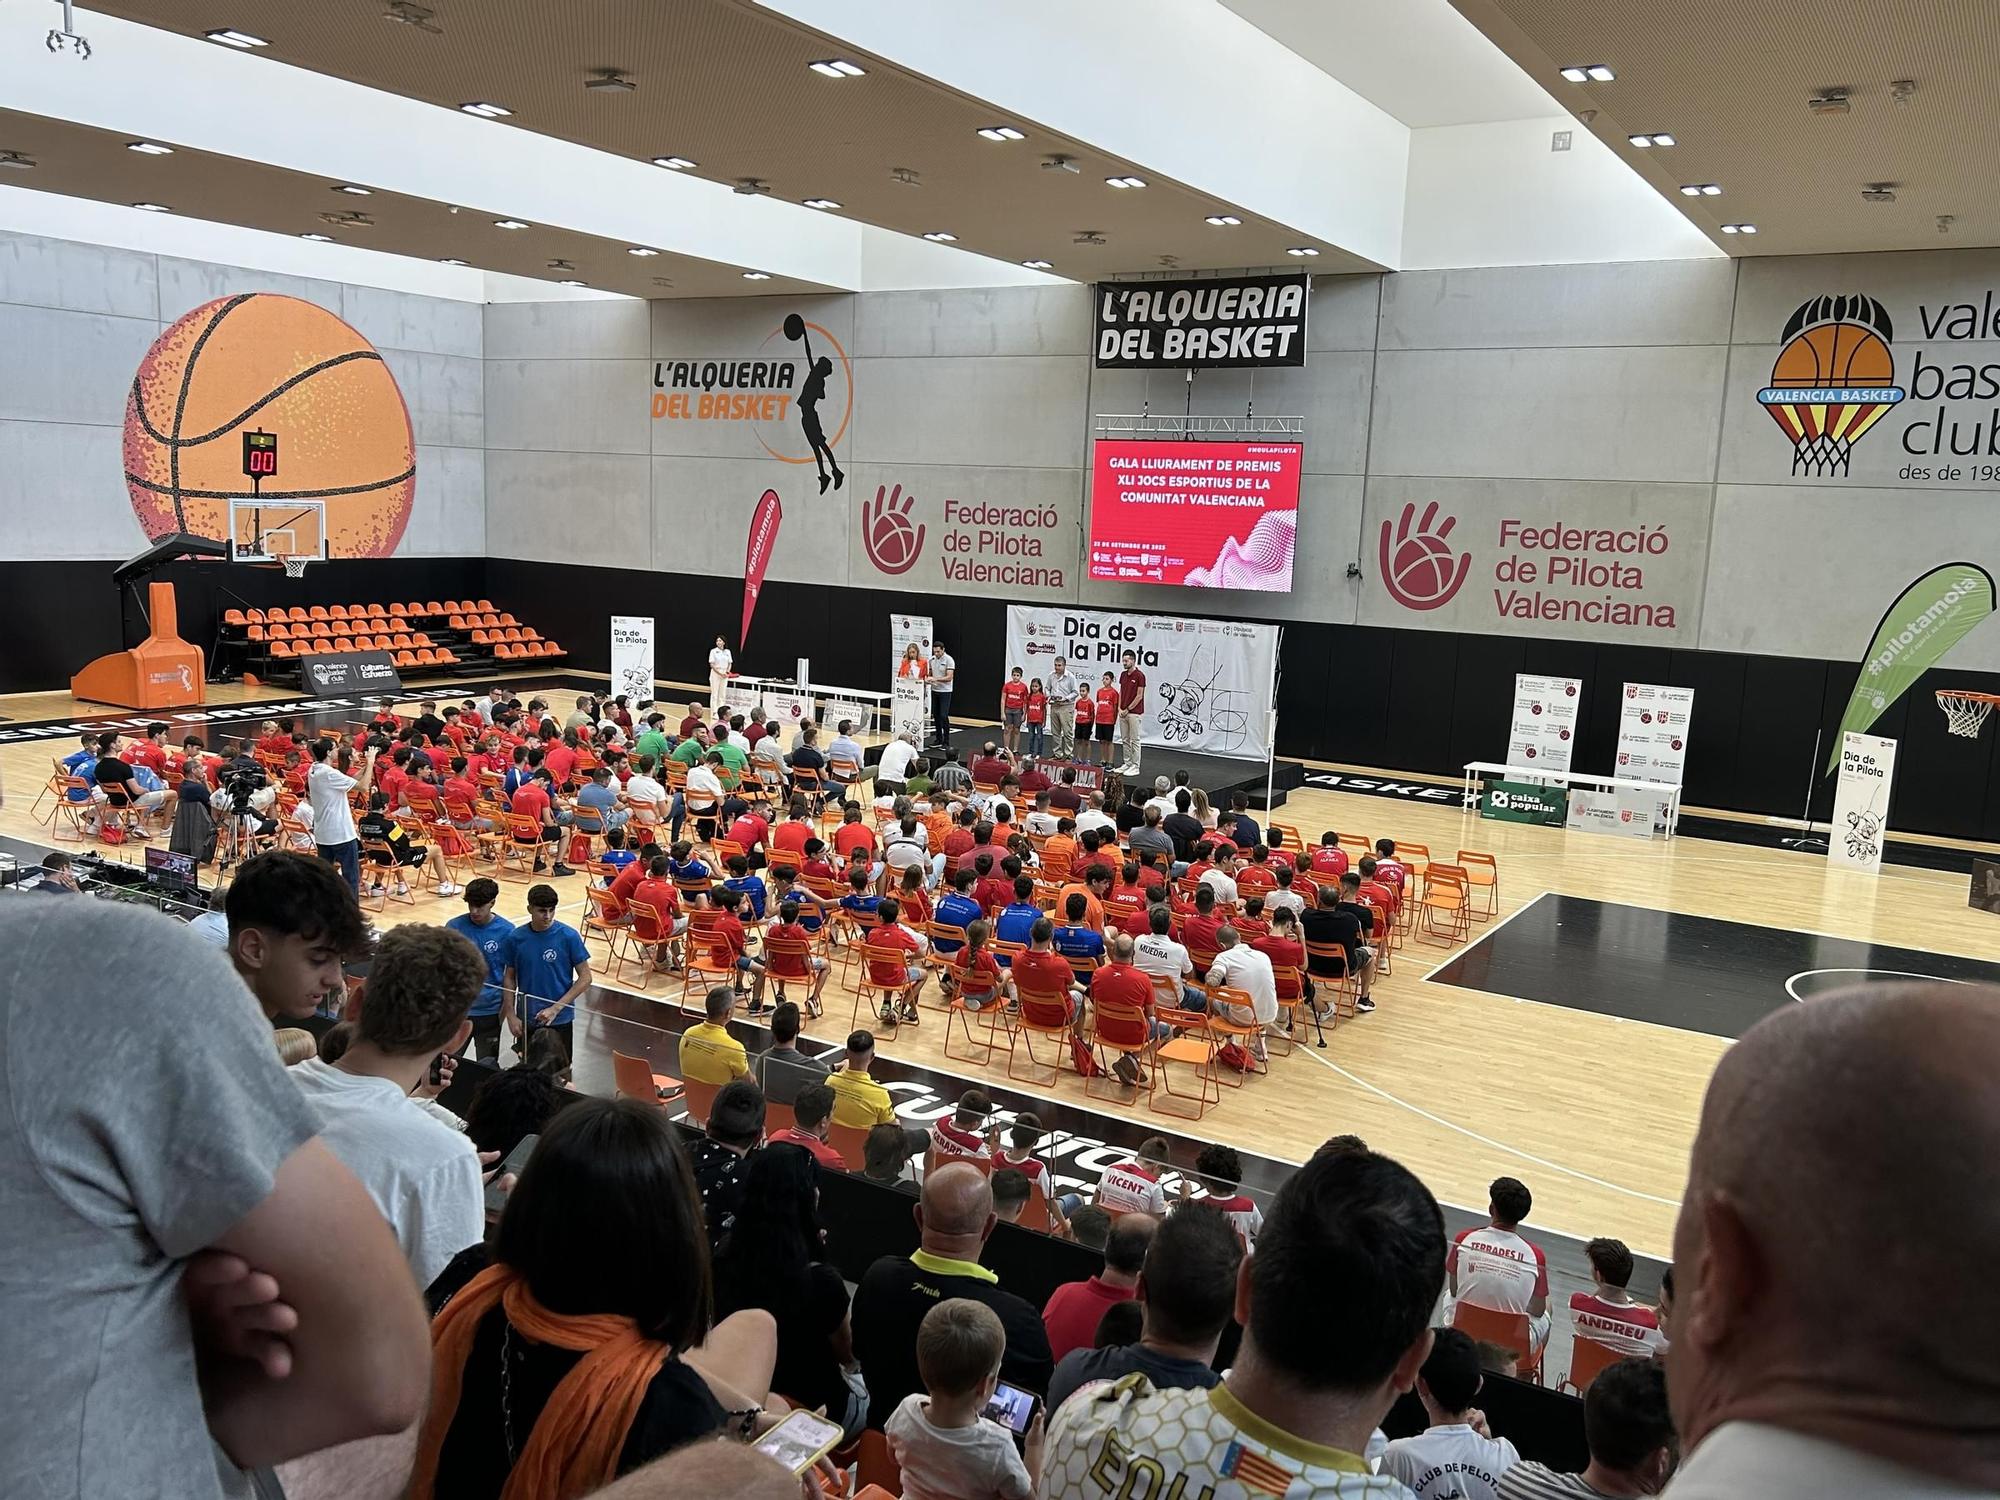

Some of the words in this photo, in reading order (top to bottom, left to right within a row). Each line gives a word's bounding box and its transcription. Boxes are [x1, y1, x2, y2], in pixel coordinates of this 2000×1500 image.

[1102, 284, 1303, 326] L'ALQUERIA
[1098, 328, 1154, 360] DEL
[1162, 324, 1298, 360] BASKET
[654, 361, 795, 392] L'ALQUERIA
[651, 393, 692, 419] DEL
[698, 394, 793, 421] BASKET
[1766, 390, 1835, 401] VALENCIA
[1841, 390, 1896, 401] BASKET
[250, 451, 273, 472] 00
[1109, 457, 1139, 469] GALA
[1142, 458, 1214, 471] LLIURAMENT
[1216, 460, 1232, 471] DE
[1235, 461, 1281, 472] PREMIS
[1899, 463, 1931, 480] des
[1937, 464, 1961, 481] de
[1117, 475, 1135, 486] XLI
[1137, 475, 1166, 487] JOCS
[1168, 476, 1233, 488] ESPORTIUS
[1235, 478, 1252, 489] DE
[1255, 478, 1271, 489] LA
[1120, 492, 1187, 504] COMUNITAT
[1189, 494, 1265, 507] VALENCIANA
[944, 500, 1058, 528] Federació
[747, 499, 776, 575] #pilotamola
[943, 529, 971, 552] de
[978, 530, 1043, 557] Pilota
[1498, 519, 1669, 555] Federació
[941, 556, 1064, 588] Valenciana
[1495, 555, 1537, 584] de
[1547, 556, 1643, 590] Pilota
[1494, 588, 1676, 629] Valenciana
[613, 629, 627, 637] Dia
[1063, 616, 1100, 639] Dia
[1108, 621, 1137, 642] de
[1867, 578, 1977, 676] #pilotamola
[625, 636, 648, 644] Pilota
[1069, 639, 1089, 660] la
[1096, 642, 1159, 667] Pilta
[362, 670, 393, 679] Esfuerzo
[172, 698, 356, 722] BASKET
[1843, 751, 1860, 762] Dia
[1862, 755, 1876, 765] de
[1844, 761, 1854, 772] la
[1856, 764, 1884, 778] Pilota
[1510, 793, 1541, 804] caixa
[1510, 801, 1556, 812] popular
[1138, 943, 1168, 960] MUEDRA
[1107, 1173, 1145, 1195] VICENT
[1471, 1241, 1516, 1260] TERRADES
[1577, 1313, 1647, 1340] ANDREU
[1415, 1466, 1443, 1493] CLUB
[1444, 1462, 1460, 1473] DE
